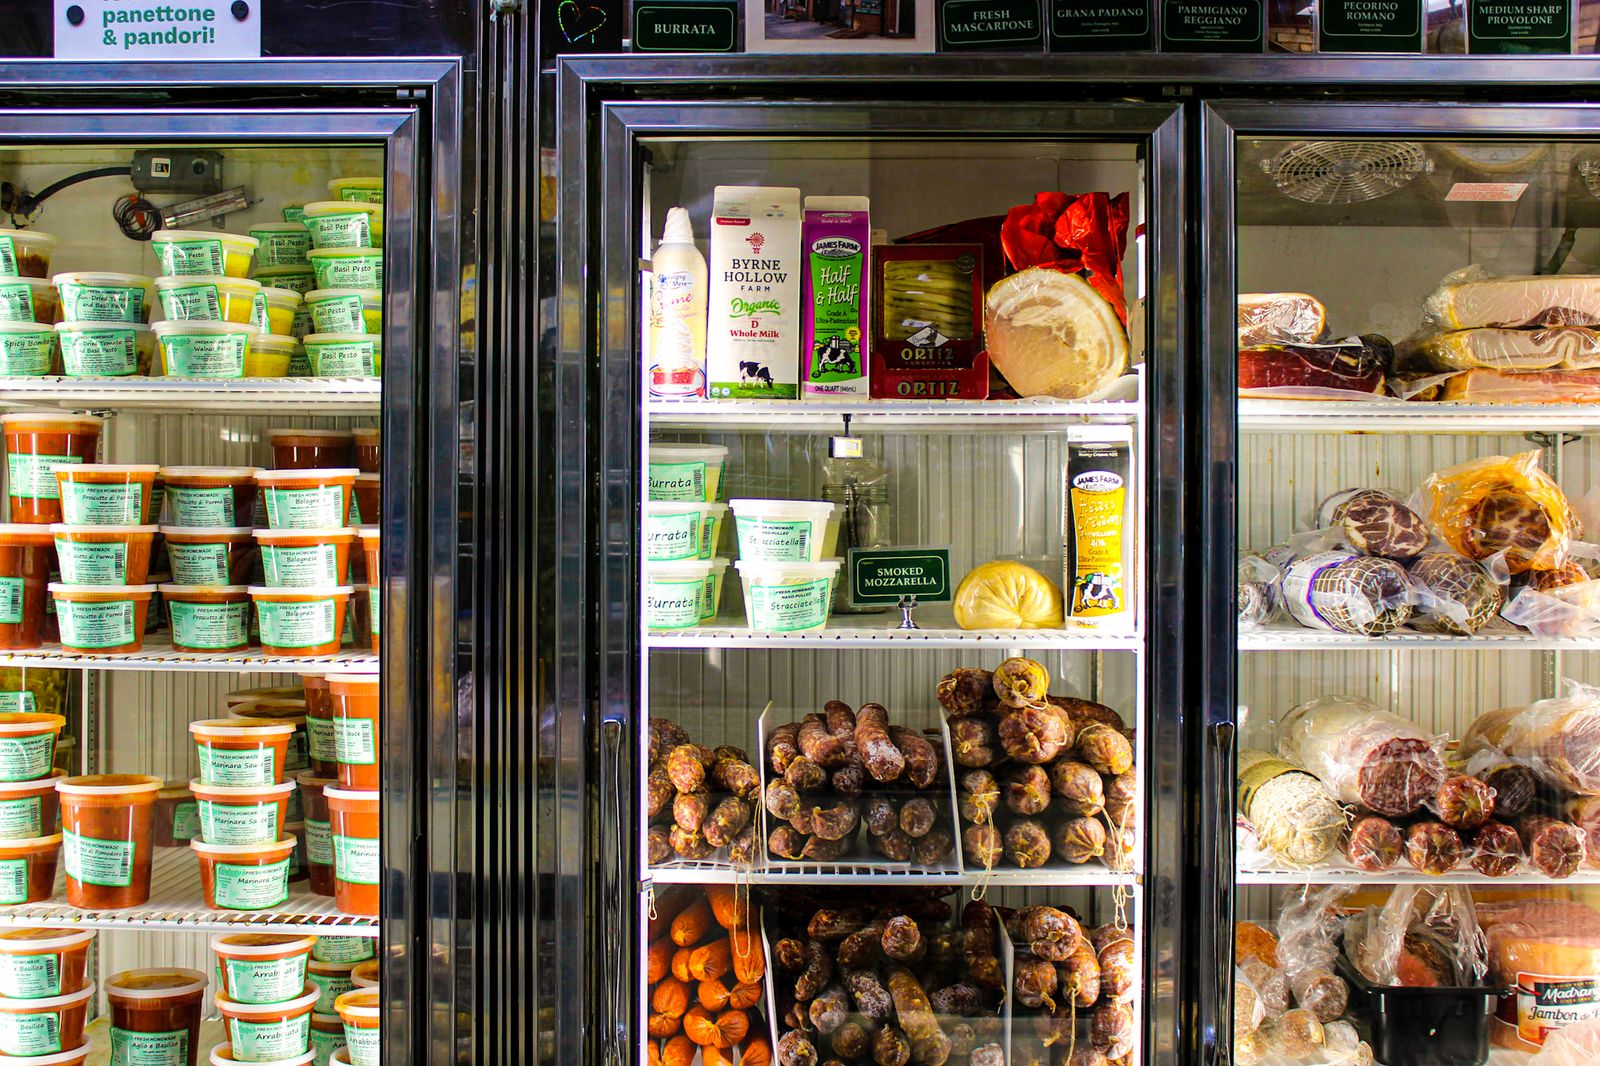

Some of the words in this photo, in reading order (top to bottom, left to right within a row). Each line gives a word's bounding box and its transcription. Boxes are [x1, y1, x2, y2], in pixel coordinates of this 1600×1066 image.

[1178, 5, 1248, 16] PARMIGIANO
[1344, 2, 1398, 11] PECORINO
[1479, 5, 1524, 14] MEDIUM
[1526, 5, 1562, 14] SHARP
[102, 6, 216, 28] panettone
[973, 10, 1010, 20] FRESH
[1057, 8, 1096, 18] GRANA
[1098, 8, 1144, 17] PADANO
[1346, 12, 1396, 21] ROMANO
[1184, 16, 1241, 26] REGGIANO
[1488, 15, 1553, 24] PROVOLONE
[654, 24, 716, 35] BURRATA
[951, 20, 1034, 34] MASCARPONE
[102, 29, 117, 45] &
[124, 27, 215, 50] pandori!
[320, 224, 333, 232] Basil
[816, 241, 838, 250] JAMES
[838, 241, 858, 251] FARM
[732, 259, 780, 271] BYRNE
[724, 272, 788, 284] HOLLOW
[820, 265, 851, 286] Half
[816, 293, 824, 306] &
[828, 284, 858, 305] Half
[730, 298, 781, 318] Organic
[751, 320, 759, 328] D
[730, 330, 757, 338] Whole
[759, 330, 780, 338] Milk
[4, 340, 26, 348] Spicy
[901, 348, 953, 360] ORTIZ
[897, 380, 959, 396] ORTIZ
[1077, 476, 1098, 485] JAMES
[1100, 475, 1119, 484] FARM
[648, 530, 688, 541] urrata
[749, 536, 799, 546] Stacciatella
[877, 567, 924, 576] SMOKED
[865, 577, 936, 587] MOZZARELLA
[253, 968, 296, 978] Arrabata
[1528, 1006, 1578, 1020] Jambon
[256, 1029, 299, 1040] Arrabata
[349, 1038, 379, 1046] Arrabbia
